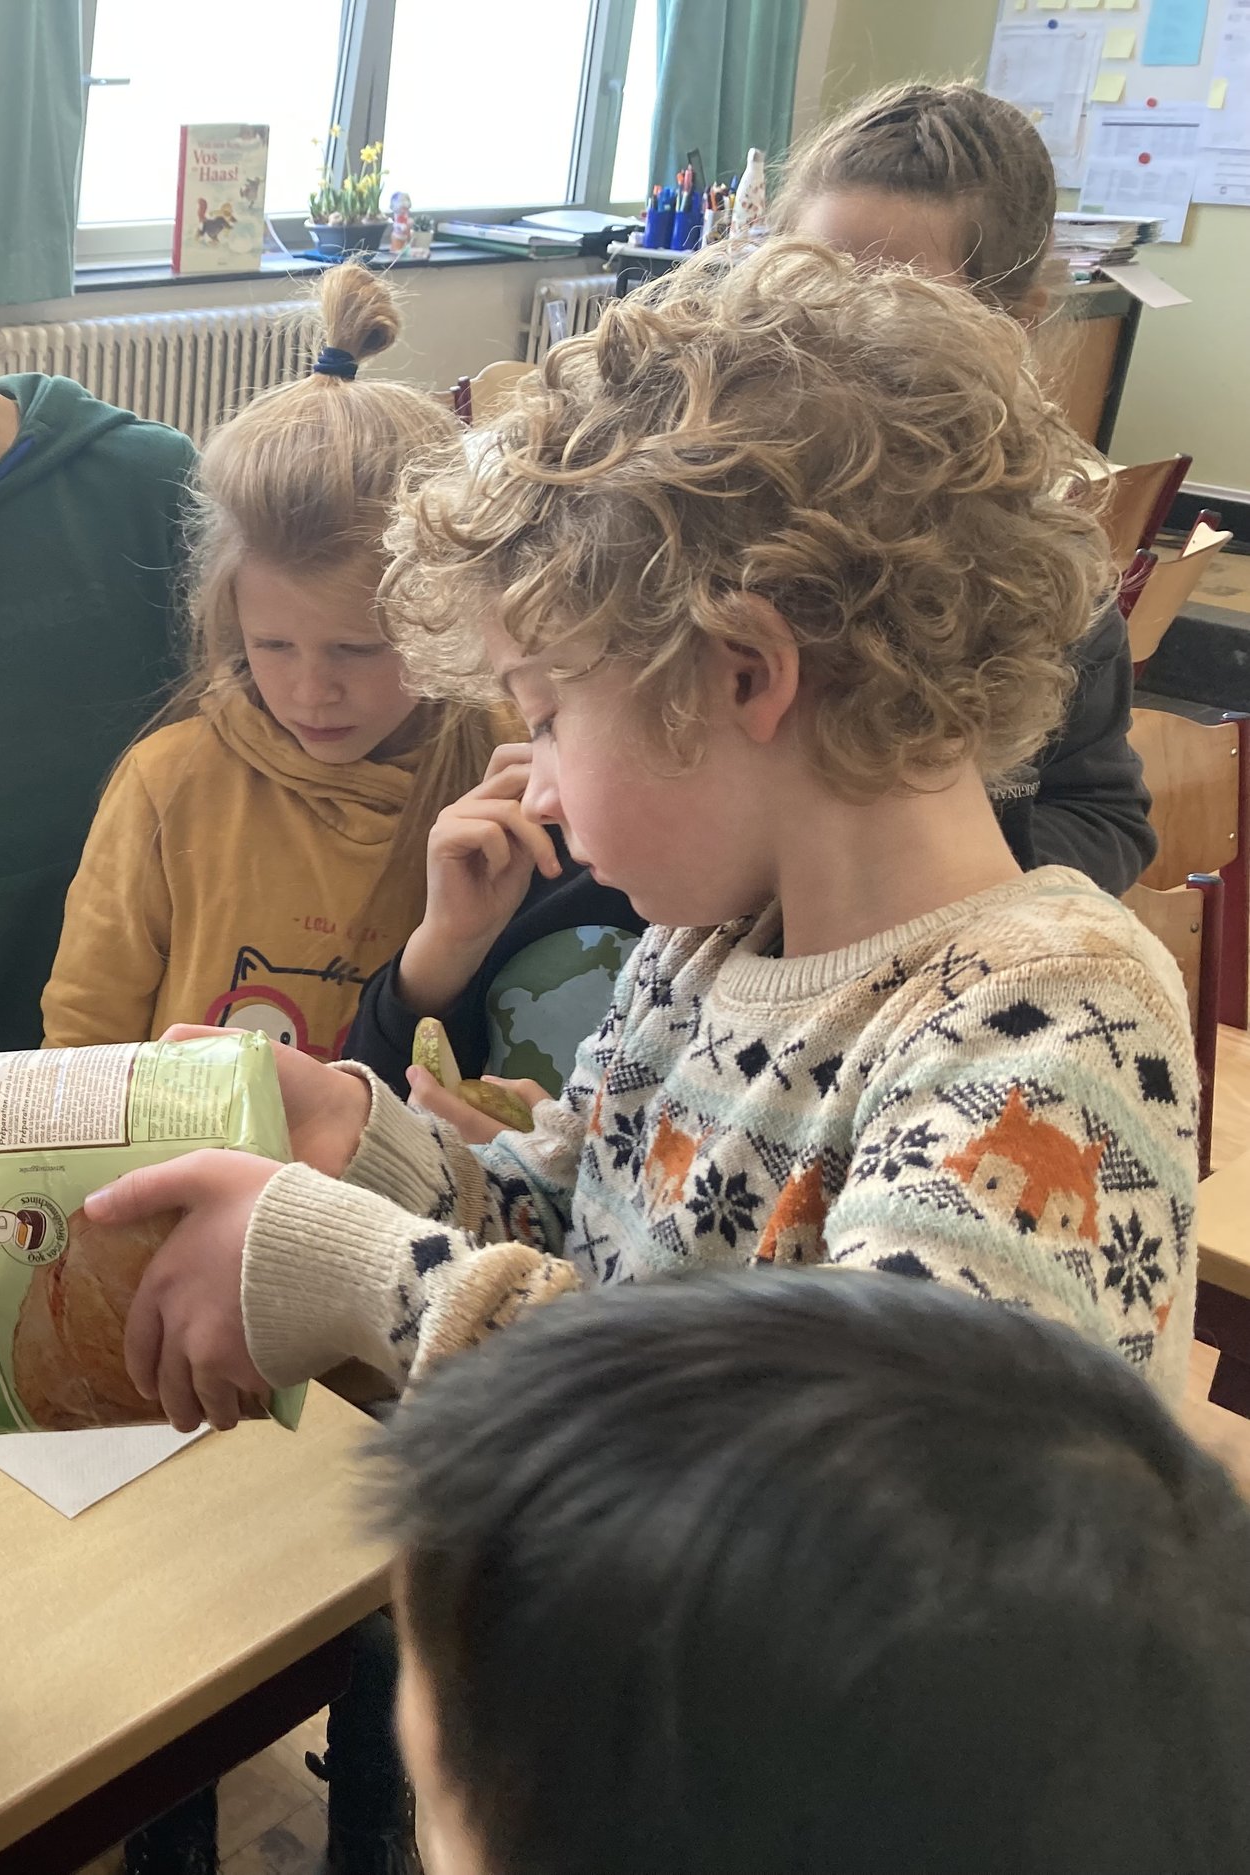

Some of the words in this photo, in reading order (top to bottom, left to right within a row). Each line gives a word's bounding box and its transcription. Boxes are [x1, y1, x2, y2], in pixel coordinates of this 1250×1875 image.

[193, 149, 218, 165] Vos
[199, 166, 239, 182] Haas!
[19, 1099, 29, 1145] Préparation
[27, 1250, 46, 1263] Ook
